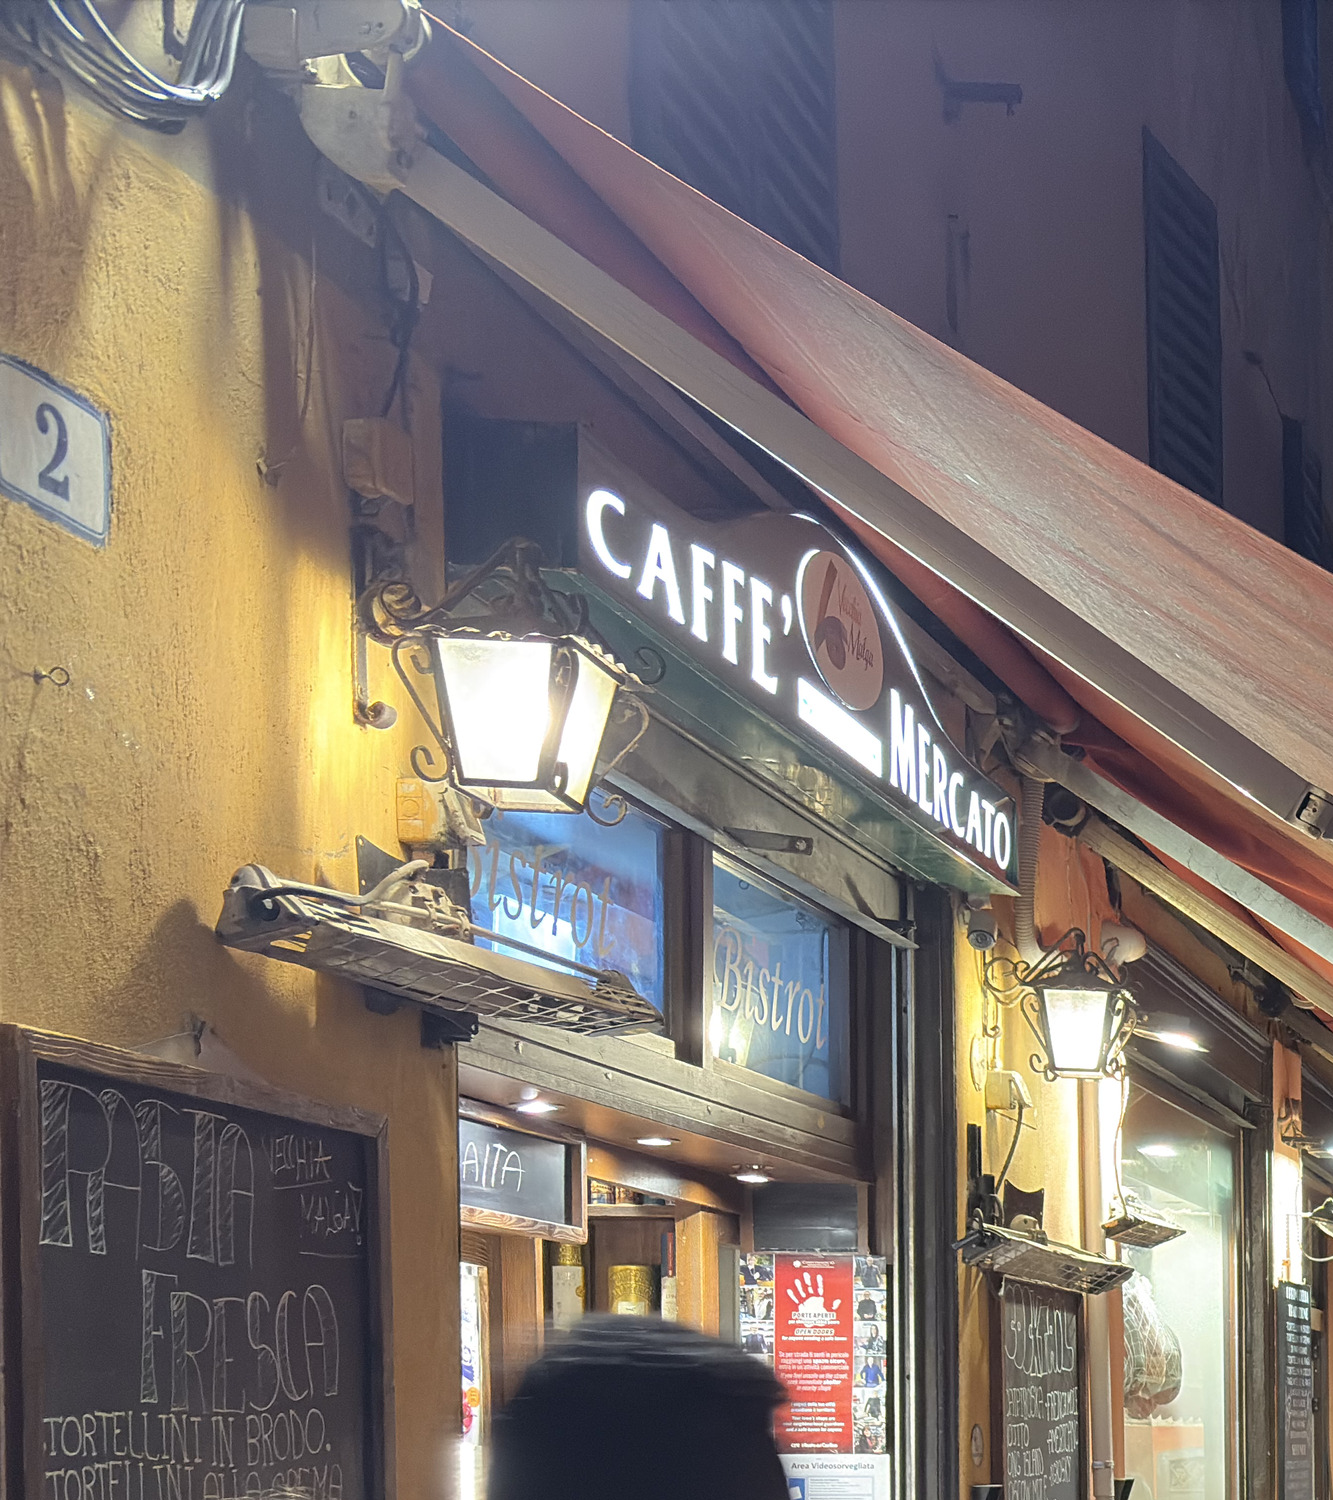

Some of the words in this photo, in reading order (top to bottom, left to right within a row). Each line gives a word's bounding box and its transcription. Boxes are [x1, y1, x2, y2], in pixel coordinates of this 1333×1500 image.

[35, 402, 71, 502] 2
[586, 489, 793, 695] CAFFE'
[889, 687, 1012, 870] MERCATO
[713, 926, 826, 1050] Bistrot
[39, 1079, 255, 1268] PASTA
[461, 1141, 526, 1192] AITA
[140, 1269, 340, 1415] FRESCA
[43, 1411, 202, 1464] TORTELLINI
[211, 1416, 236, 1467] IN
[791, 1462, 810, 1470] Area
[811, 1462, 875, 1471] Videosorvegliata
[1006, 1423, 1030, 1450] OJITO
[1006, 1451, 1021, 1477] ONG
